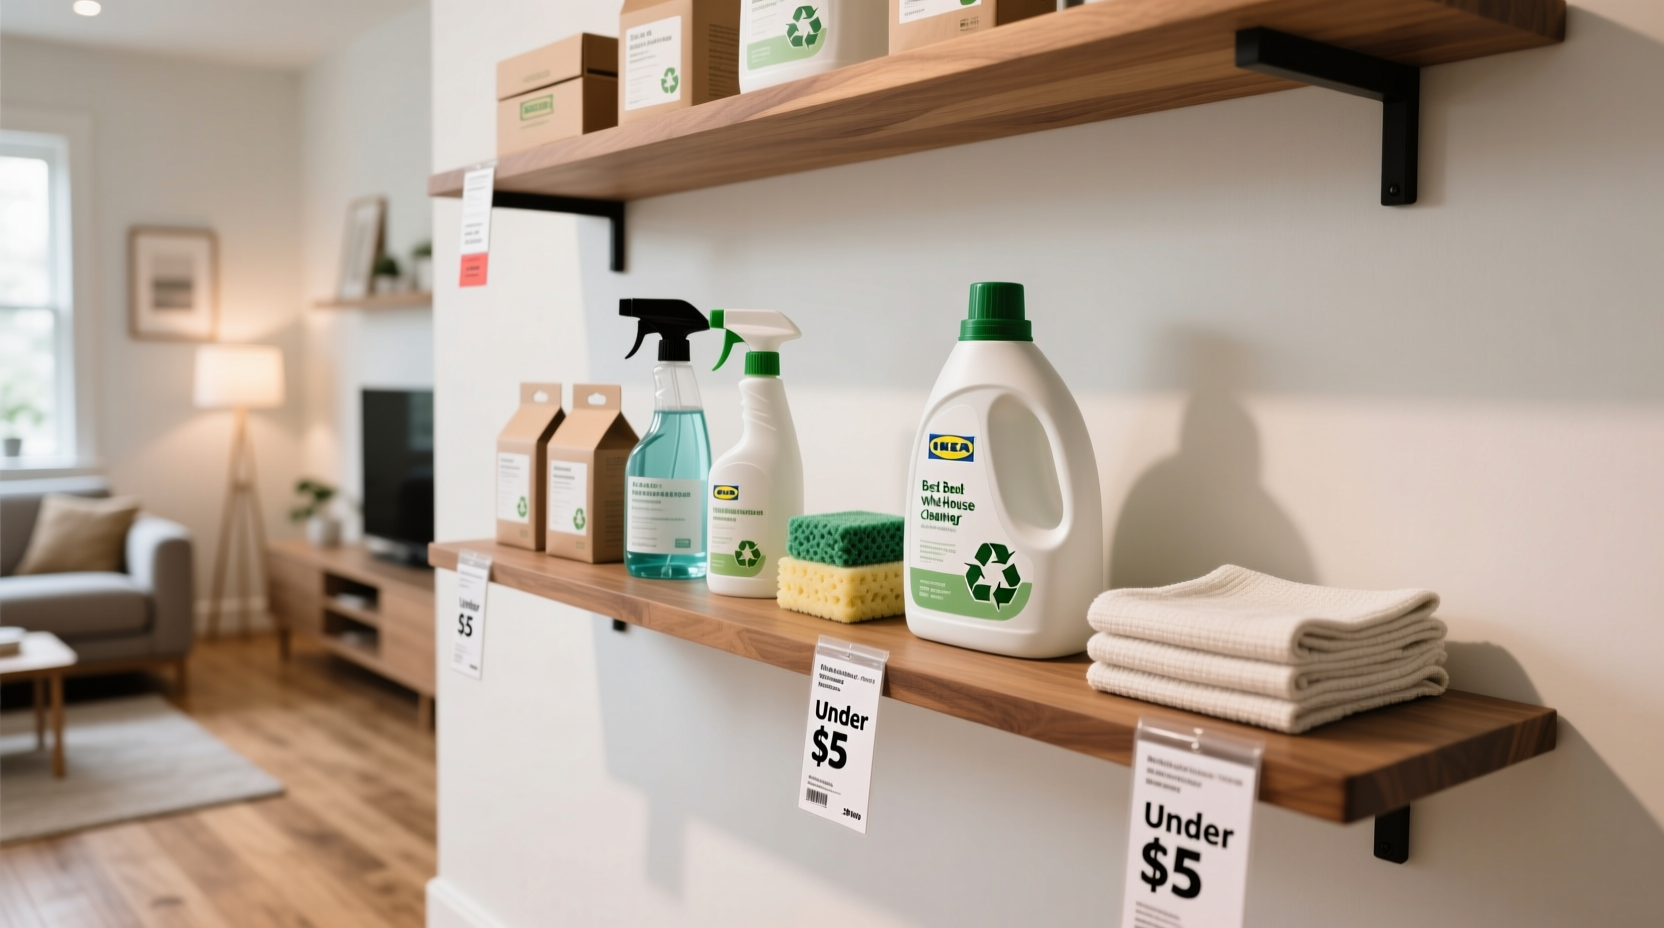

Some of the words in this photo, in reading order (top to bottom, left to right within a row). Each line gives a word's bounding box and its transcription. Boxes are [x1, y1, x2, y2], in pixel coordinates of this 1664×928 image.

[942, 495, 975, 511] House
[457, 613, 473, 637] $5
[815, 699, 869, 731] Under
[811, 725, 848, 769] $5
[1145, 801, 1234, 848] Under
[1140, 837, 1202, 899] $5
